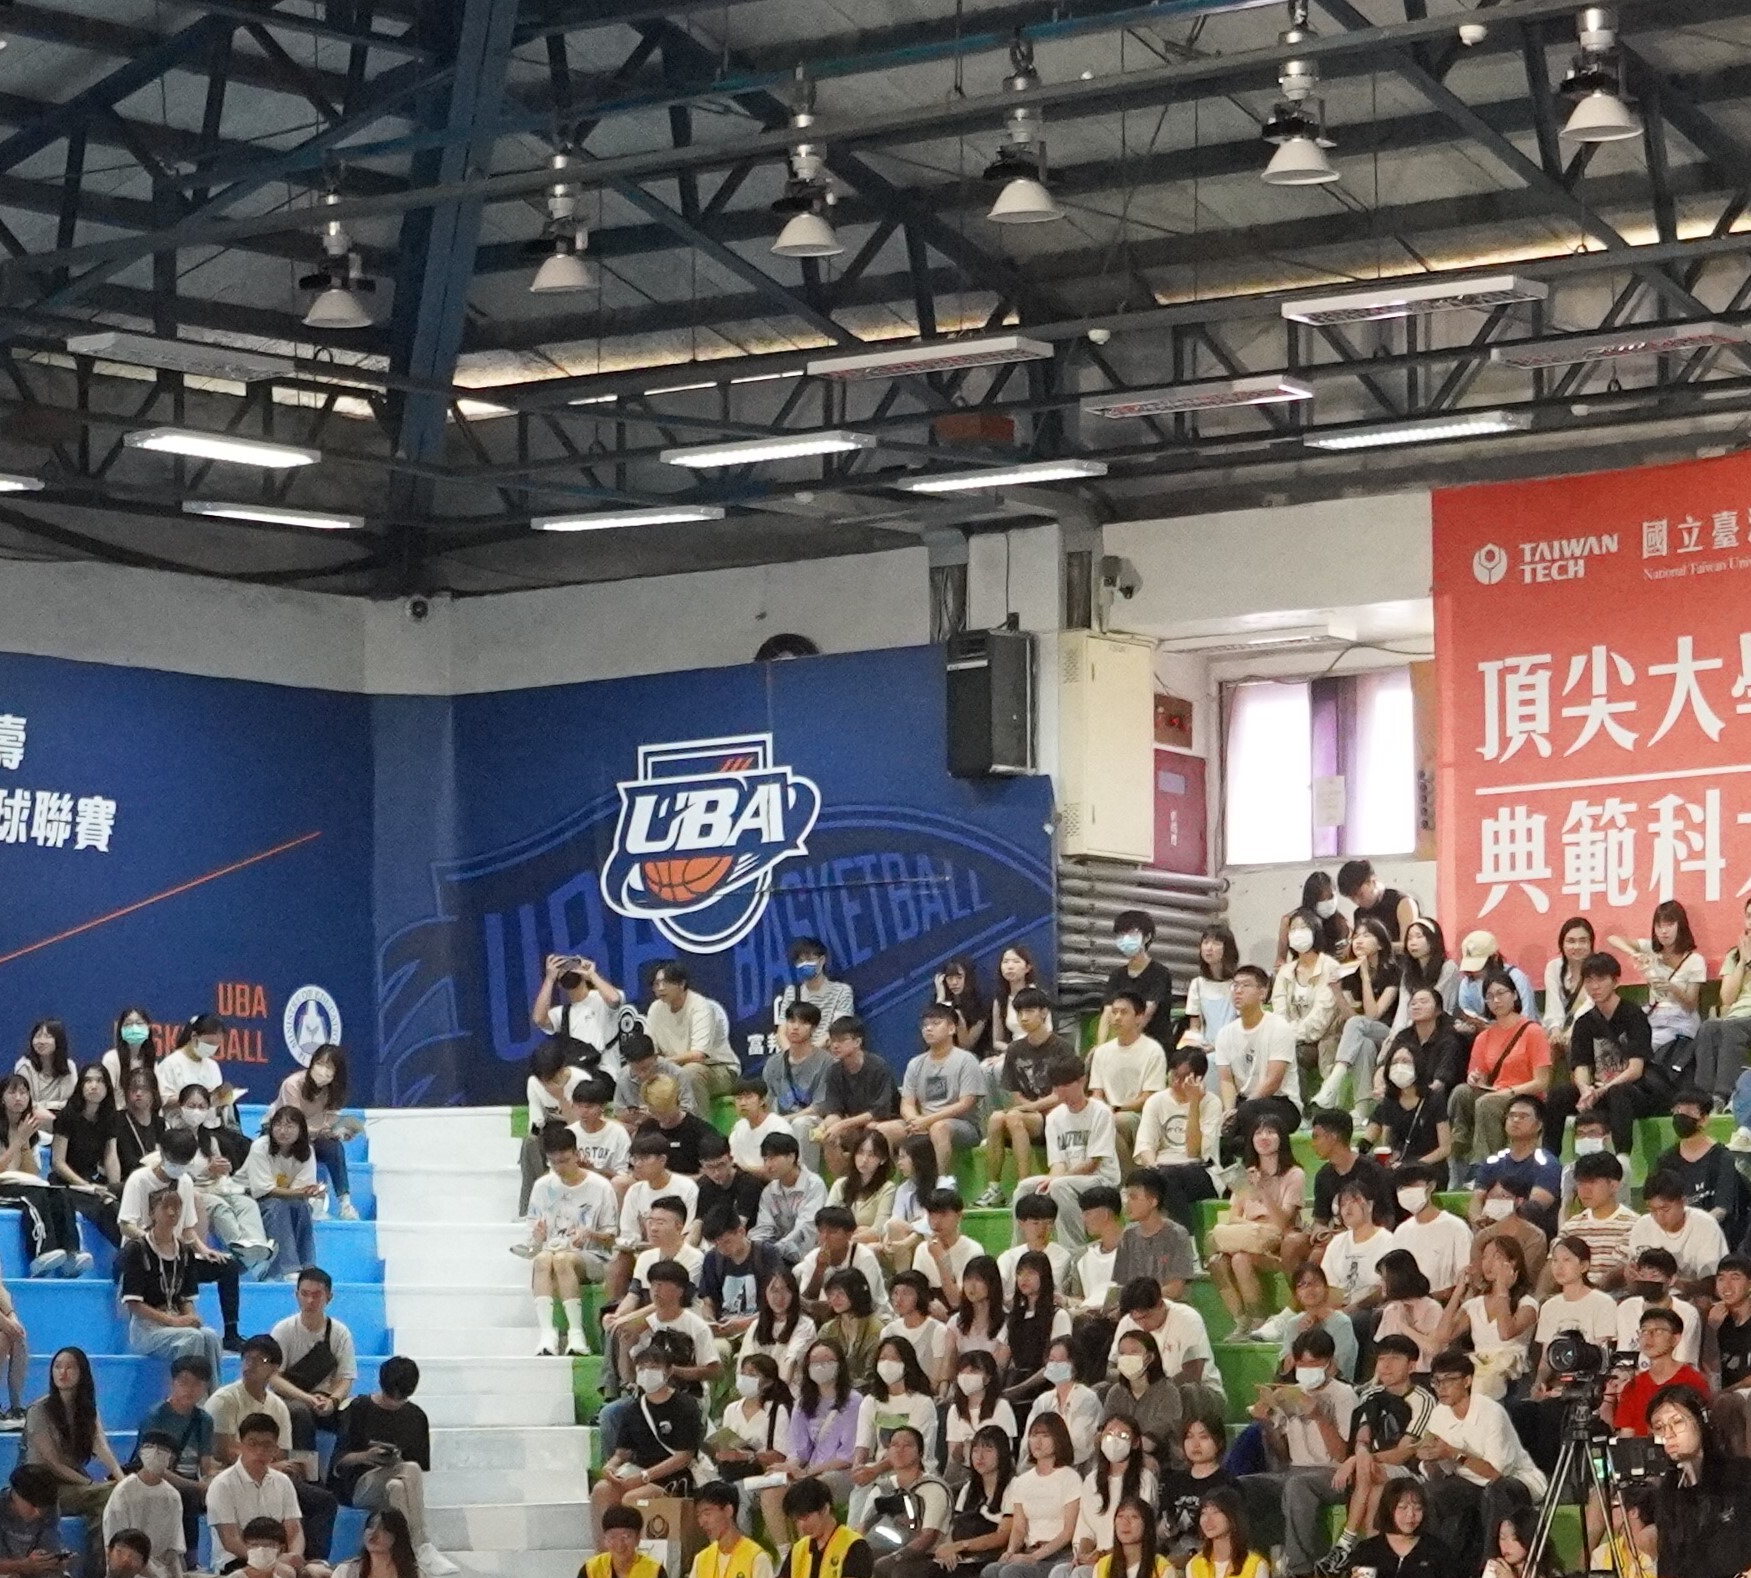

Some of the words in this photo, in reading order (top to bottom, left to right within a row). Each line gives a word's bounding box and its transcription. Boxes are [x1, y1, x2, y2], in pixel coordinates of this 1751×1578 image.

[1519, 534, 1619, 562] TAIWAN
[1519, 558, 1586, 585] TECH
[1644, 562, 1688, 581] National
[1690, 558, 1727, 575] Taiwan
[625, 782, 786, 855] UBA
[217, 982, 268, 1019] UBA
